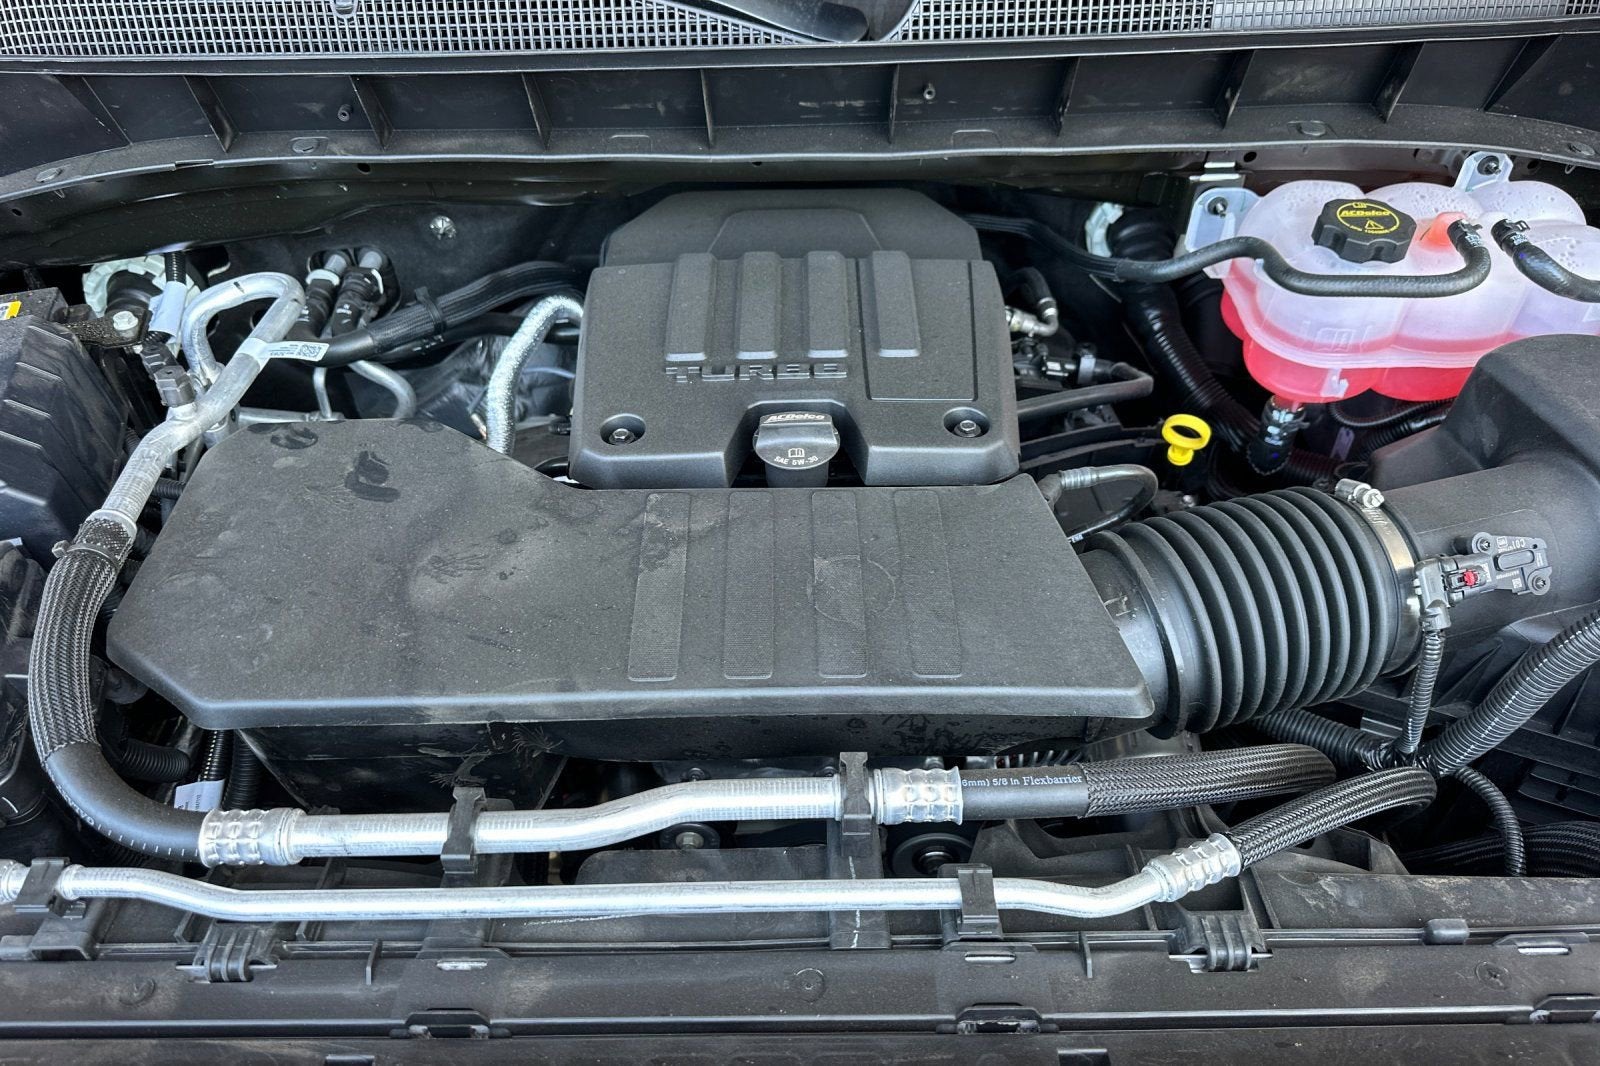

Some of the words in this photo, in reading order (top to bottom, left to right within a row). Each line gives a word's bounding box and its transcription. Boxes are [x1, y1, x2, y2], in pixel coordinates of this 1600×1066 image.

[1339, 209, 1391, 218] ACDelco
[764, 413, 826, 424] ACDelco
[774, 455, 790, 465] SAE
[993, 777, 1009, 786] 5/8
[1022, 774, 1083, 786] Flexbarrier
